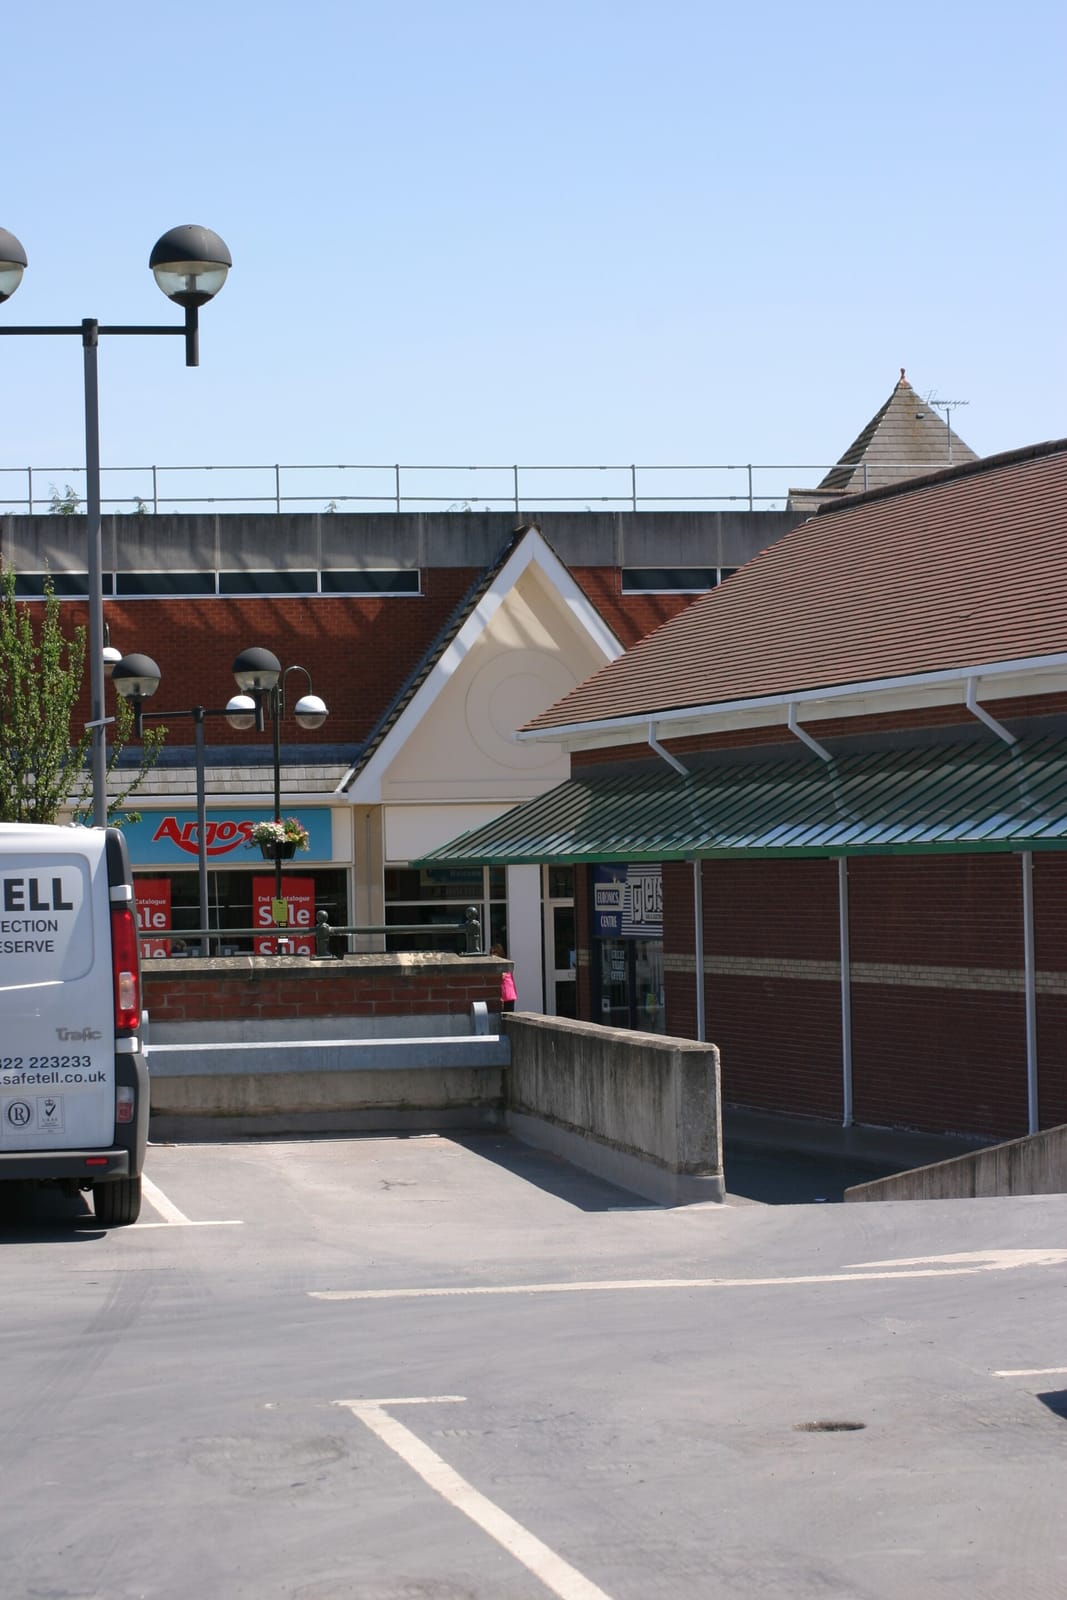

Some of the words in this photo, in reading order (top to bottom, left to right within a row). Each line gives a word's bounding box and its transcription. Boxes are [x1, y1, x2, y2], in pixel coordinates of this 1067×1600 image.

[153, 816, 255, 857] Argos
[258, 904, 310, 925] Sle
[600, 915, 618, 928] CENTRE
[1, 919, 58, 933] ECTION
[0, 940, 55, 953] SERVE
[55, 1027, 103, 1042] Trafic
[0, 1057, 23, 1070] 22
[29, 1055, 92, 1068] 223233
